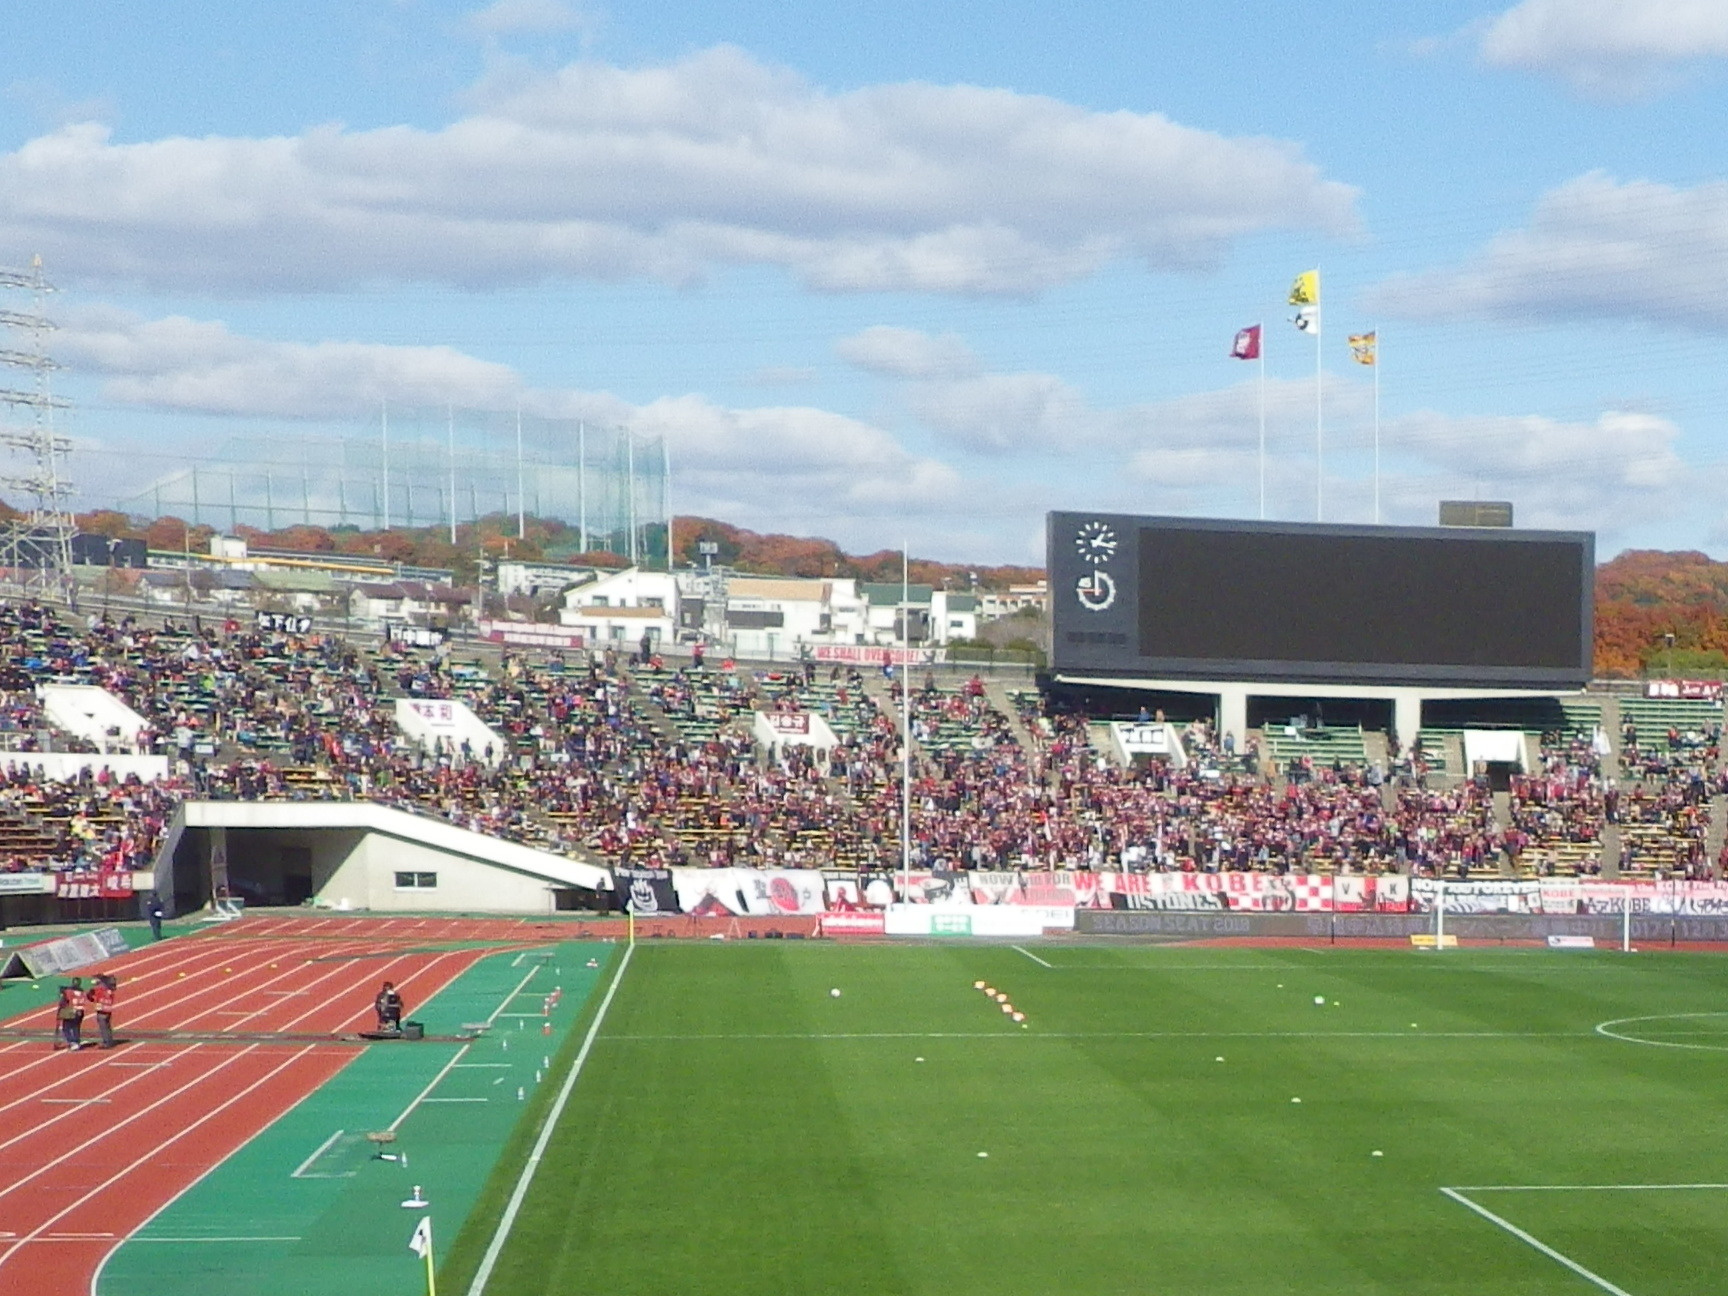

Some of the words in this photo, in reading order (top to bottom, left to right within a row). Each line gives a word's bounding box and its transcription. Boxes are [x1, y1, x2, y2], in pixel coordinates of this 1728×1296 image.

[1073, 872, 1103, 890] WE
[1114, 874, 1151, 895] ARE
[1181, 873, 1265, 894] KOBE
